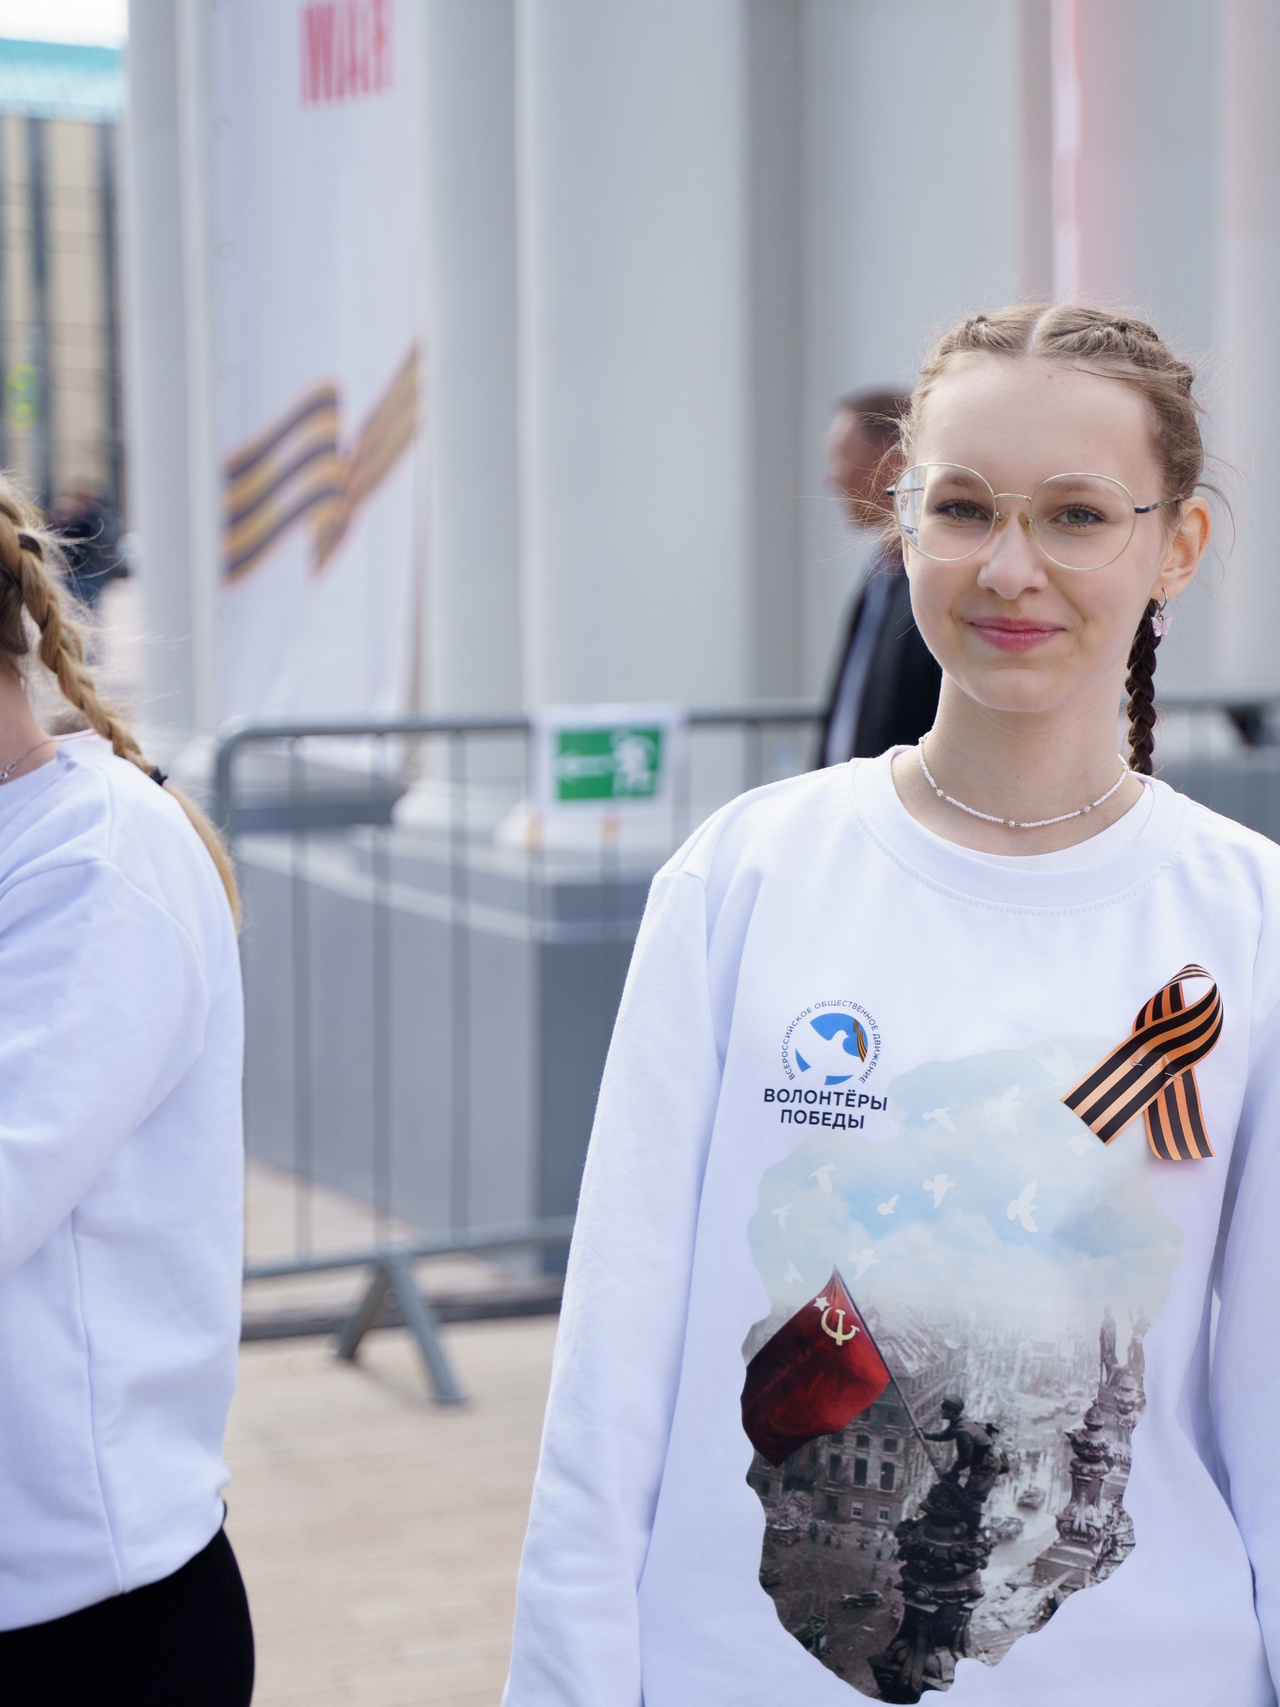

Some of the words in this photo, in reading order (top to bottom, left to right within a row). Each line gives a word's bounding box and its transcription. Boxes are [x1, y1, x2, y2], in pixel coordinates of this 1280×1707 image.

[781, 1007, 812, 1080] ВСЕРОССИЙСКОЕ
[814, 1000, 879, 1031] ОБЩЕСТВЕННОЕ
[858, 1033, 881, 1083] ДВИЖЕНИЕ
[763, 1088, 888, 1111] ВОЛОНТЁРЫ
[780, 1109, 865, 1130] ПОБЕДЫ
